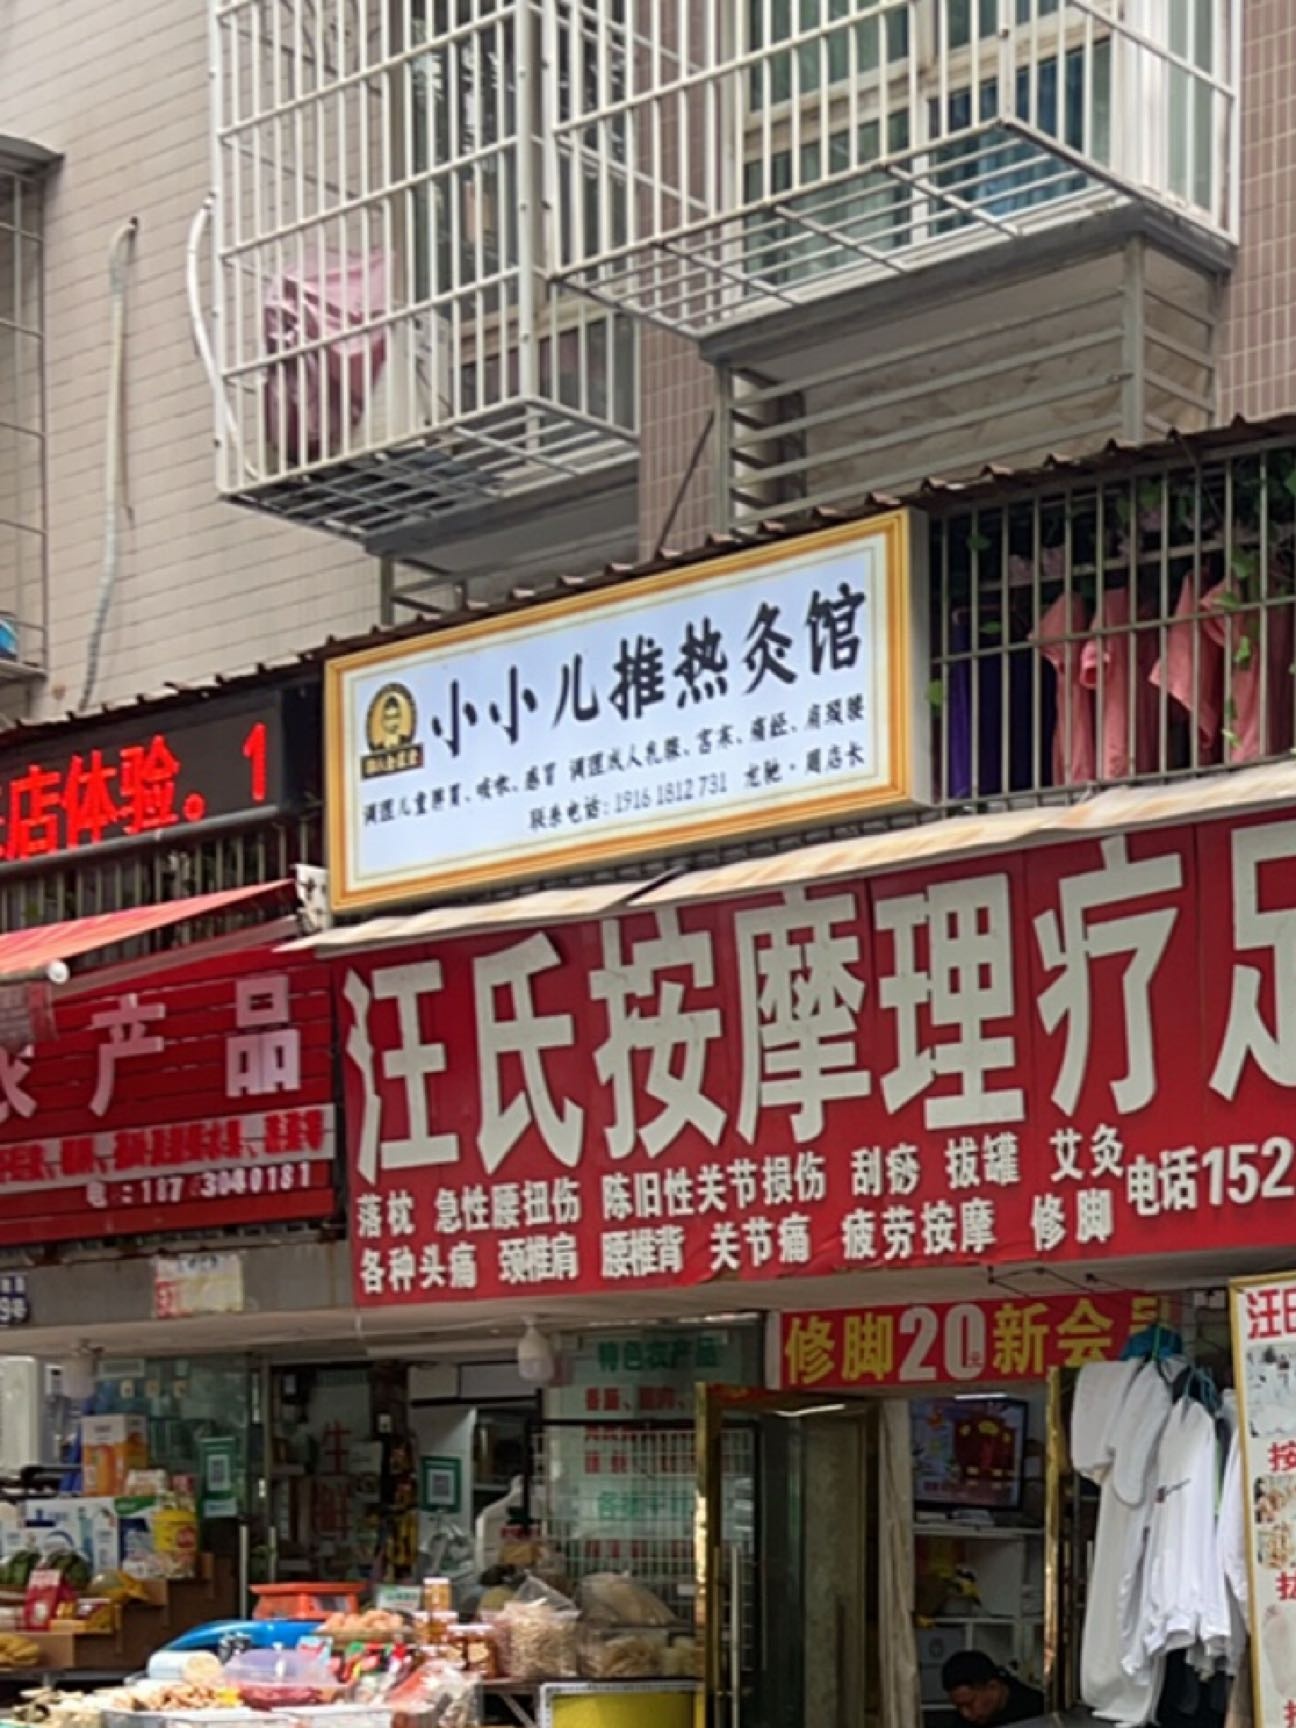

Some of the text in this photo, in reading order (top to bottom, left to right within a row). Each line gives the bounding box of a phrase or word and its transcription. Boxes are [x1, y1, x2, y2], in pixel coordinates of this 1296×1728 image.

[431, 582, 866, 758] 小小儿推热灸馆
[0, 735, 206, 861] 店体验。
[357, 1190, 415, 1239] 落枕
[434, 1176, 582, 1234] 急性腰扭伤
[601, 1151, 827, 1222] 陈旧性关节损伤
[850, 1145, 922, 1197] 刮痧
[944, 1132, 1022, 1191] 拔罐
[1049, 1121, 1125, 1185] 艾灸
[358, 1188, 1114, 1295] 各种头痛 颈椎肩 腰椎背 关节痛 疲劳按摩 修脚
